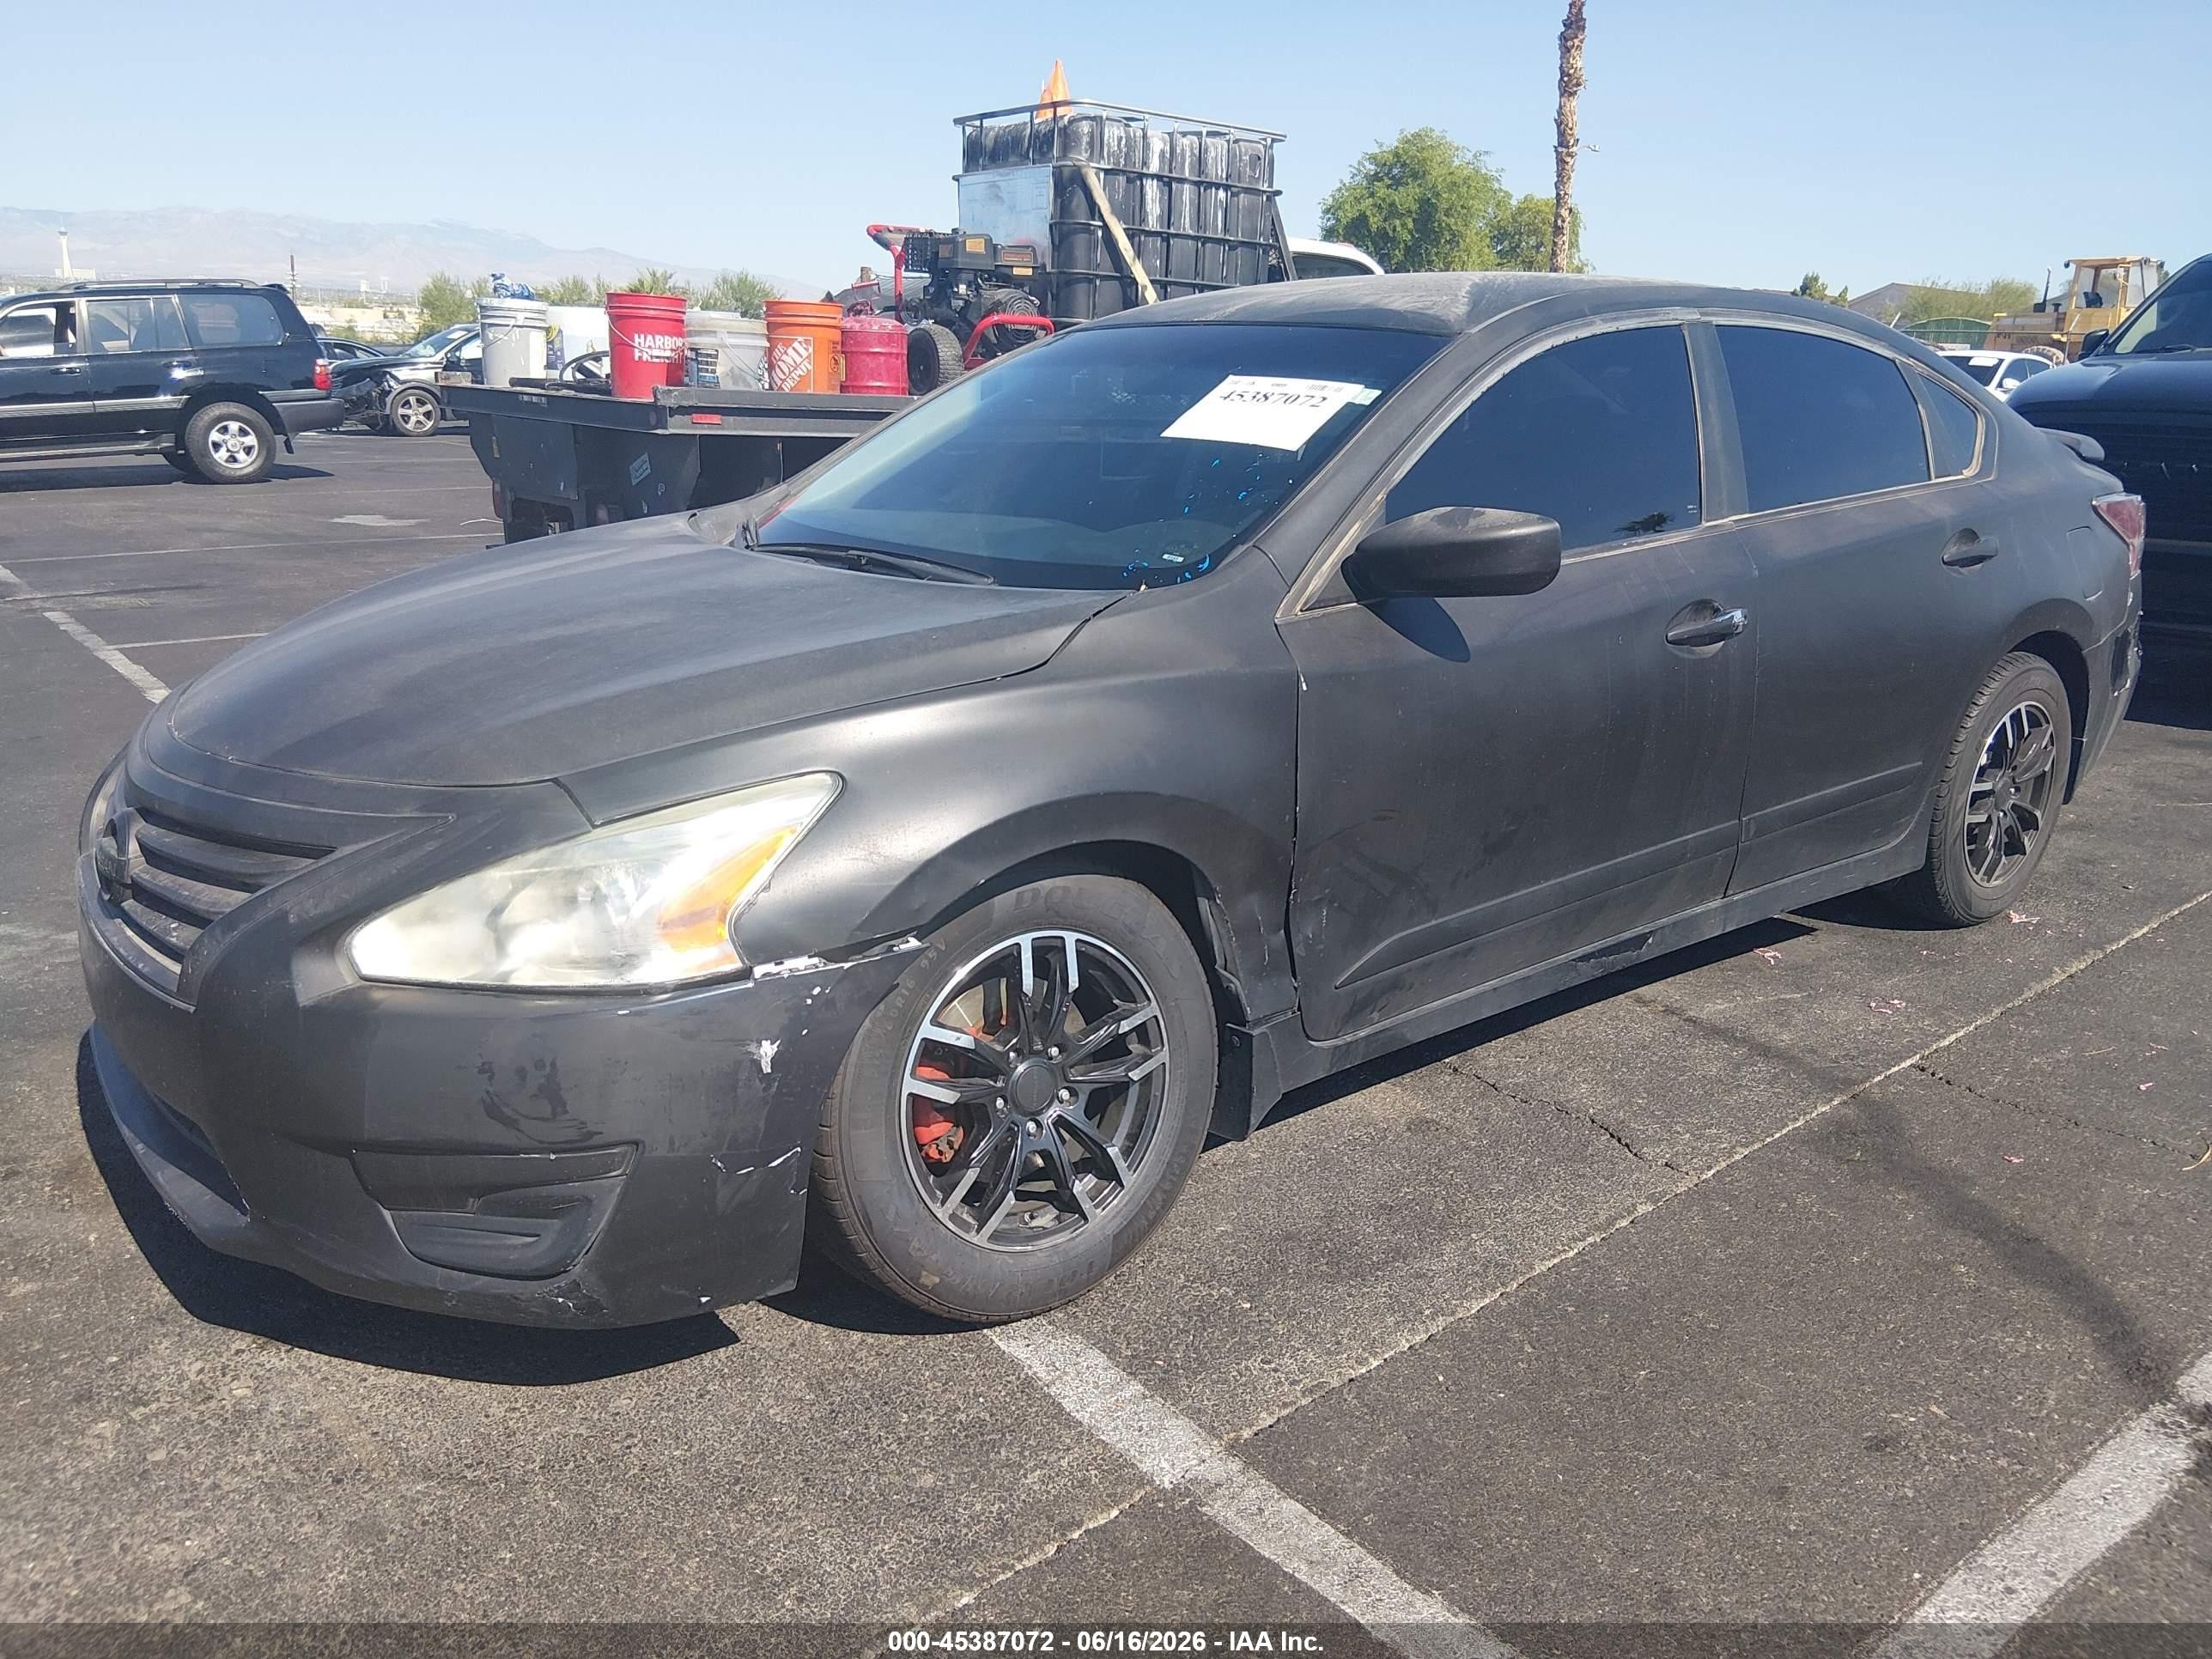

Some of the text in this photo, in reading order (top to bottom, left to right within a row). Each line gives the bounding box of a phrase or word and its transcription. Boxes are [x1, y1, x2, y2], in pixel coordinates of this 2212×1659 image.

[634, 333, 684, 350] HARBOR
[771, 343, 787, 365] THE
[781, 359, 812, 392] DEPOT
[1220, 390, 1328, 408] 45387072
